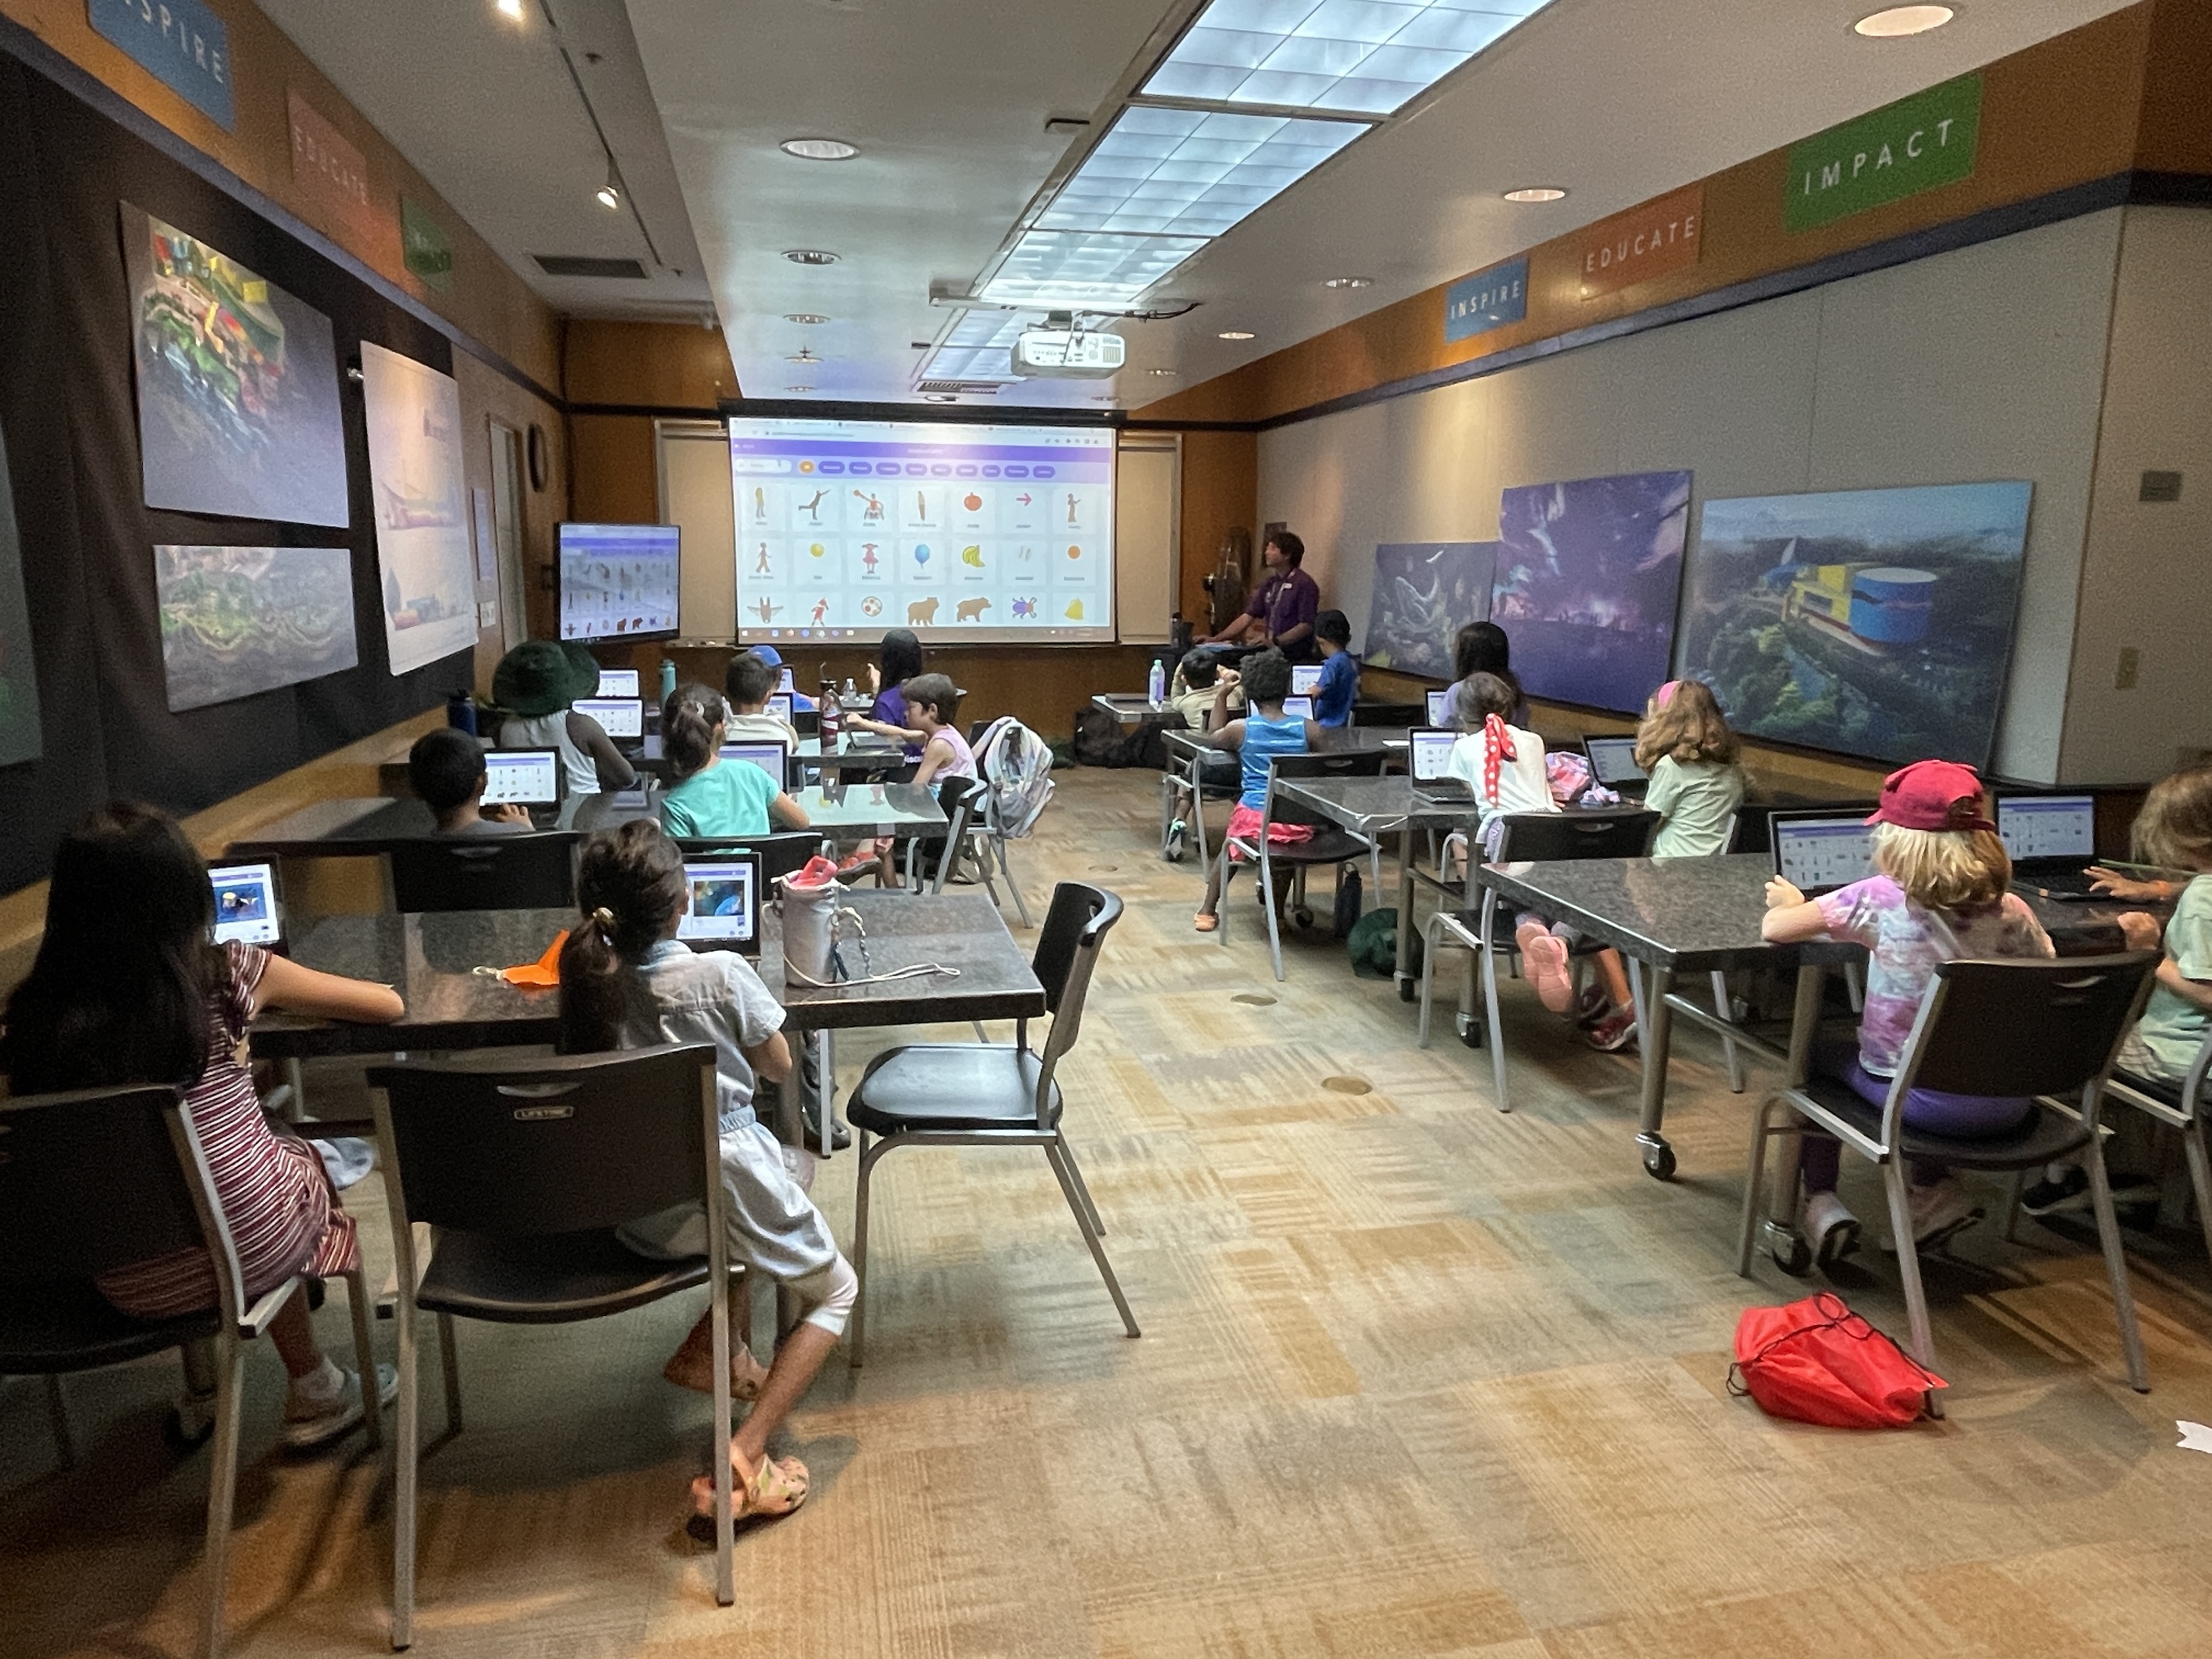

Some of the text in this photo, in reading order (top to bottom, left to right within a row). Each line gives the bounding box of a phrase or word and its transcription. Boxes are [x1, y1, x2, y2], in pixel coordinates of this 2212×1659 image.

[125, 0, 224, 83] SPIRE
[1804, 119, 1953, 195] IMPACT
[1586, 216, 1695, 272] EDUCATE
[1451, 280, 1520, 319] INSPIRE
